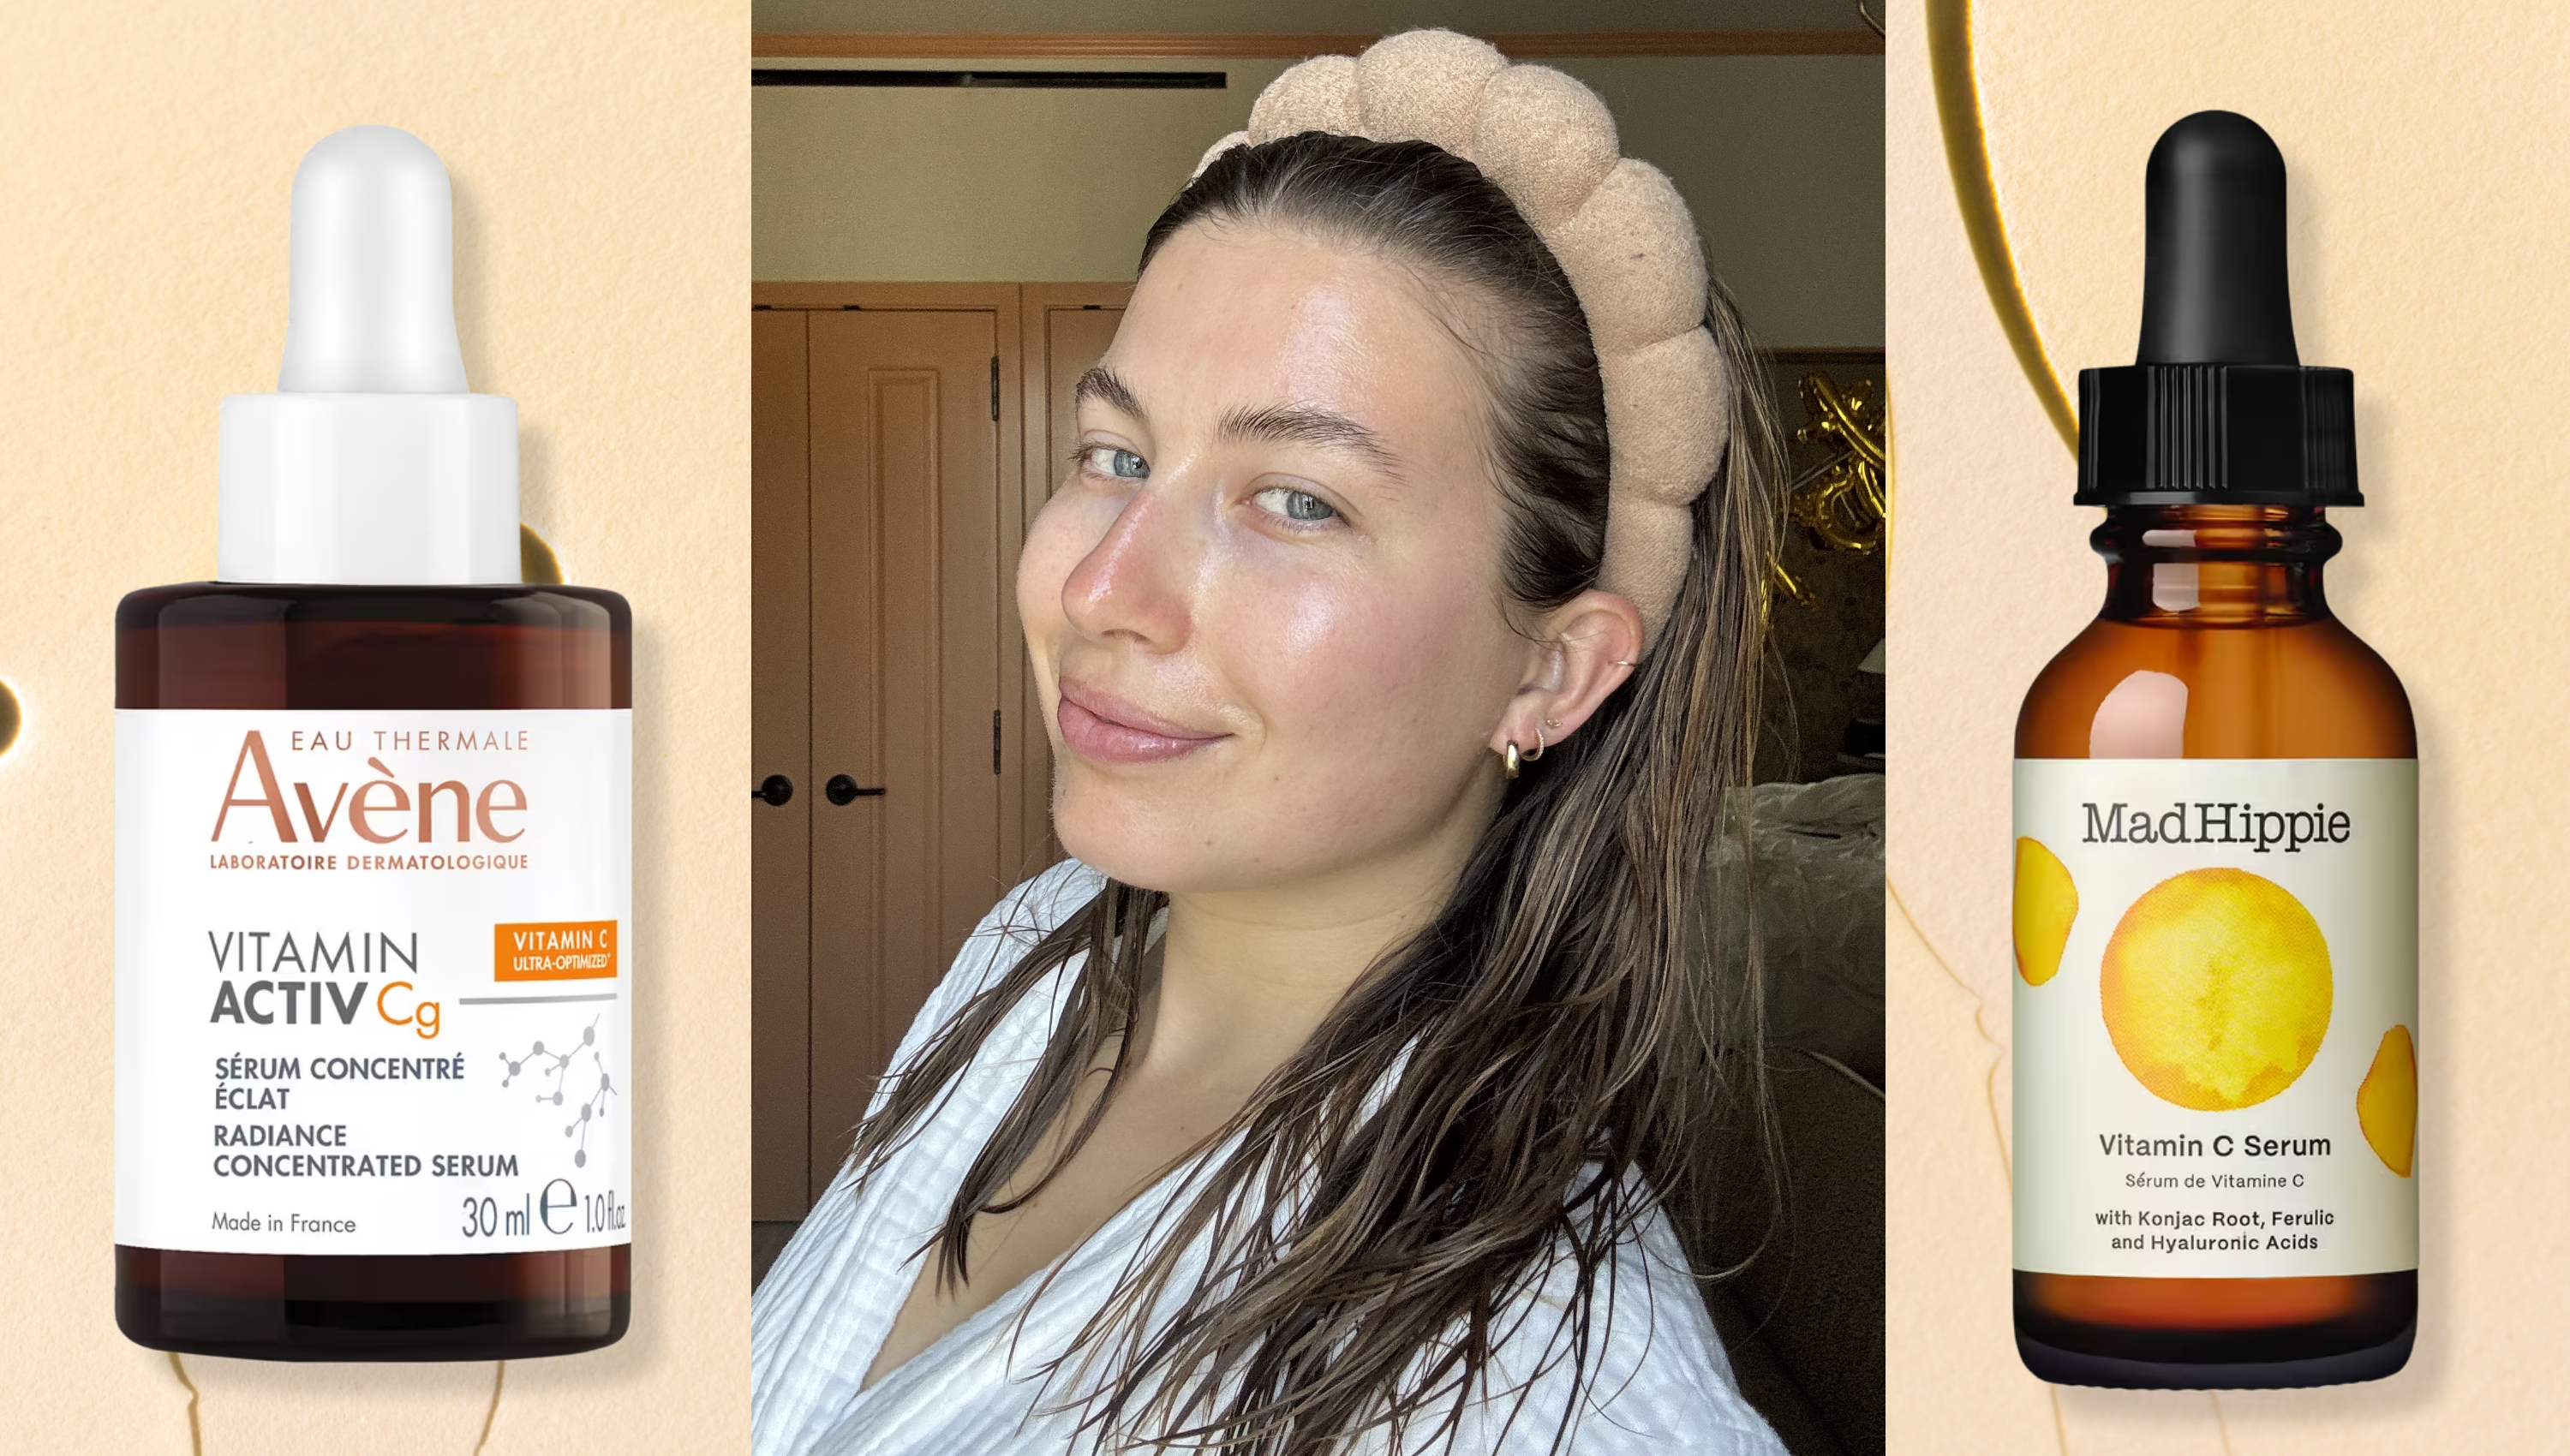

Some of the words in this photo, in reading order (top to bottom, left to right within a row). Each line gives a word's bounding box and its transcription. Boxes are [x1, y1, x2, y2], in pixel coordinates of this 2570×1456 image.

[292, 731, 351, 750] EAU
[374, 731, 527, 750] THERMALE
[212, 731, 527, 844] Avène
[211, 855, 336, 869] LABORATOIRE
[348, 856, 527, 869] DERMATOLOGIQUE
[514, 931, 592, 950] VITAMIN
[599, 928, 607, 948] C
[208, 931, 416, 973] VITAMIN
[210, 981, 368, 1024] ACTIV
[377, 981, 439, 1040] Cg
[216, 1053, 301, 1080] SÉRUM
[310, 1052, 463, 1079] CONCENTRÉ
[216, 1082, 290, 1109] ÉCLAT
[215, 1125, 346, 1146] RADIANCE
[2100, 1134, 2202, 1156] Vitamin
[2214, 1136, 2233, 1156] C
[2244, 1136, 2330, 1156] Serum
[214, 1155, 421, 1177] CONCENTRATED
[432, 1155, 518, 1177] SERUM
[2126, 1173, 2178, 1187] Sérum
[2184, 1174, 2205, 1188] de
[2212, 1174, 2286, 1188] Vitamine
[2292, 1174, 2304, 1187] C
[212, 1212, 260, 1231] Made
[268, 1214, 283, 1231] in
[291, 1214, 356, 1232] France
[463, 1197, 497, 1238] 30
[506, 1193, 529, 1236] ml
[585, 1194, 604, 1232] 1.0
[2095, 1210, 2131, 1225] with
[2139, 1211, 2204, 1229] Konjac
[2213, 1212, 2265, 1229] Root,
[2273, 1209, 2334, 1226] Ferulic
[2112, 1235, 2143, 1250] and
[2152, 1232, 2259, 1253] Hyaluronic
[2266, 1234, 2317, 1250] Acids
